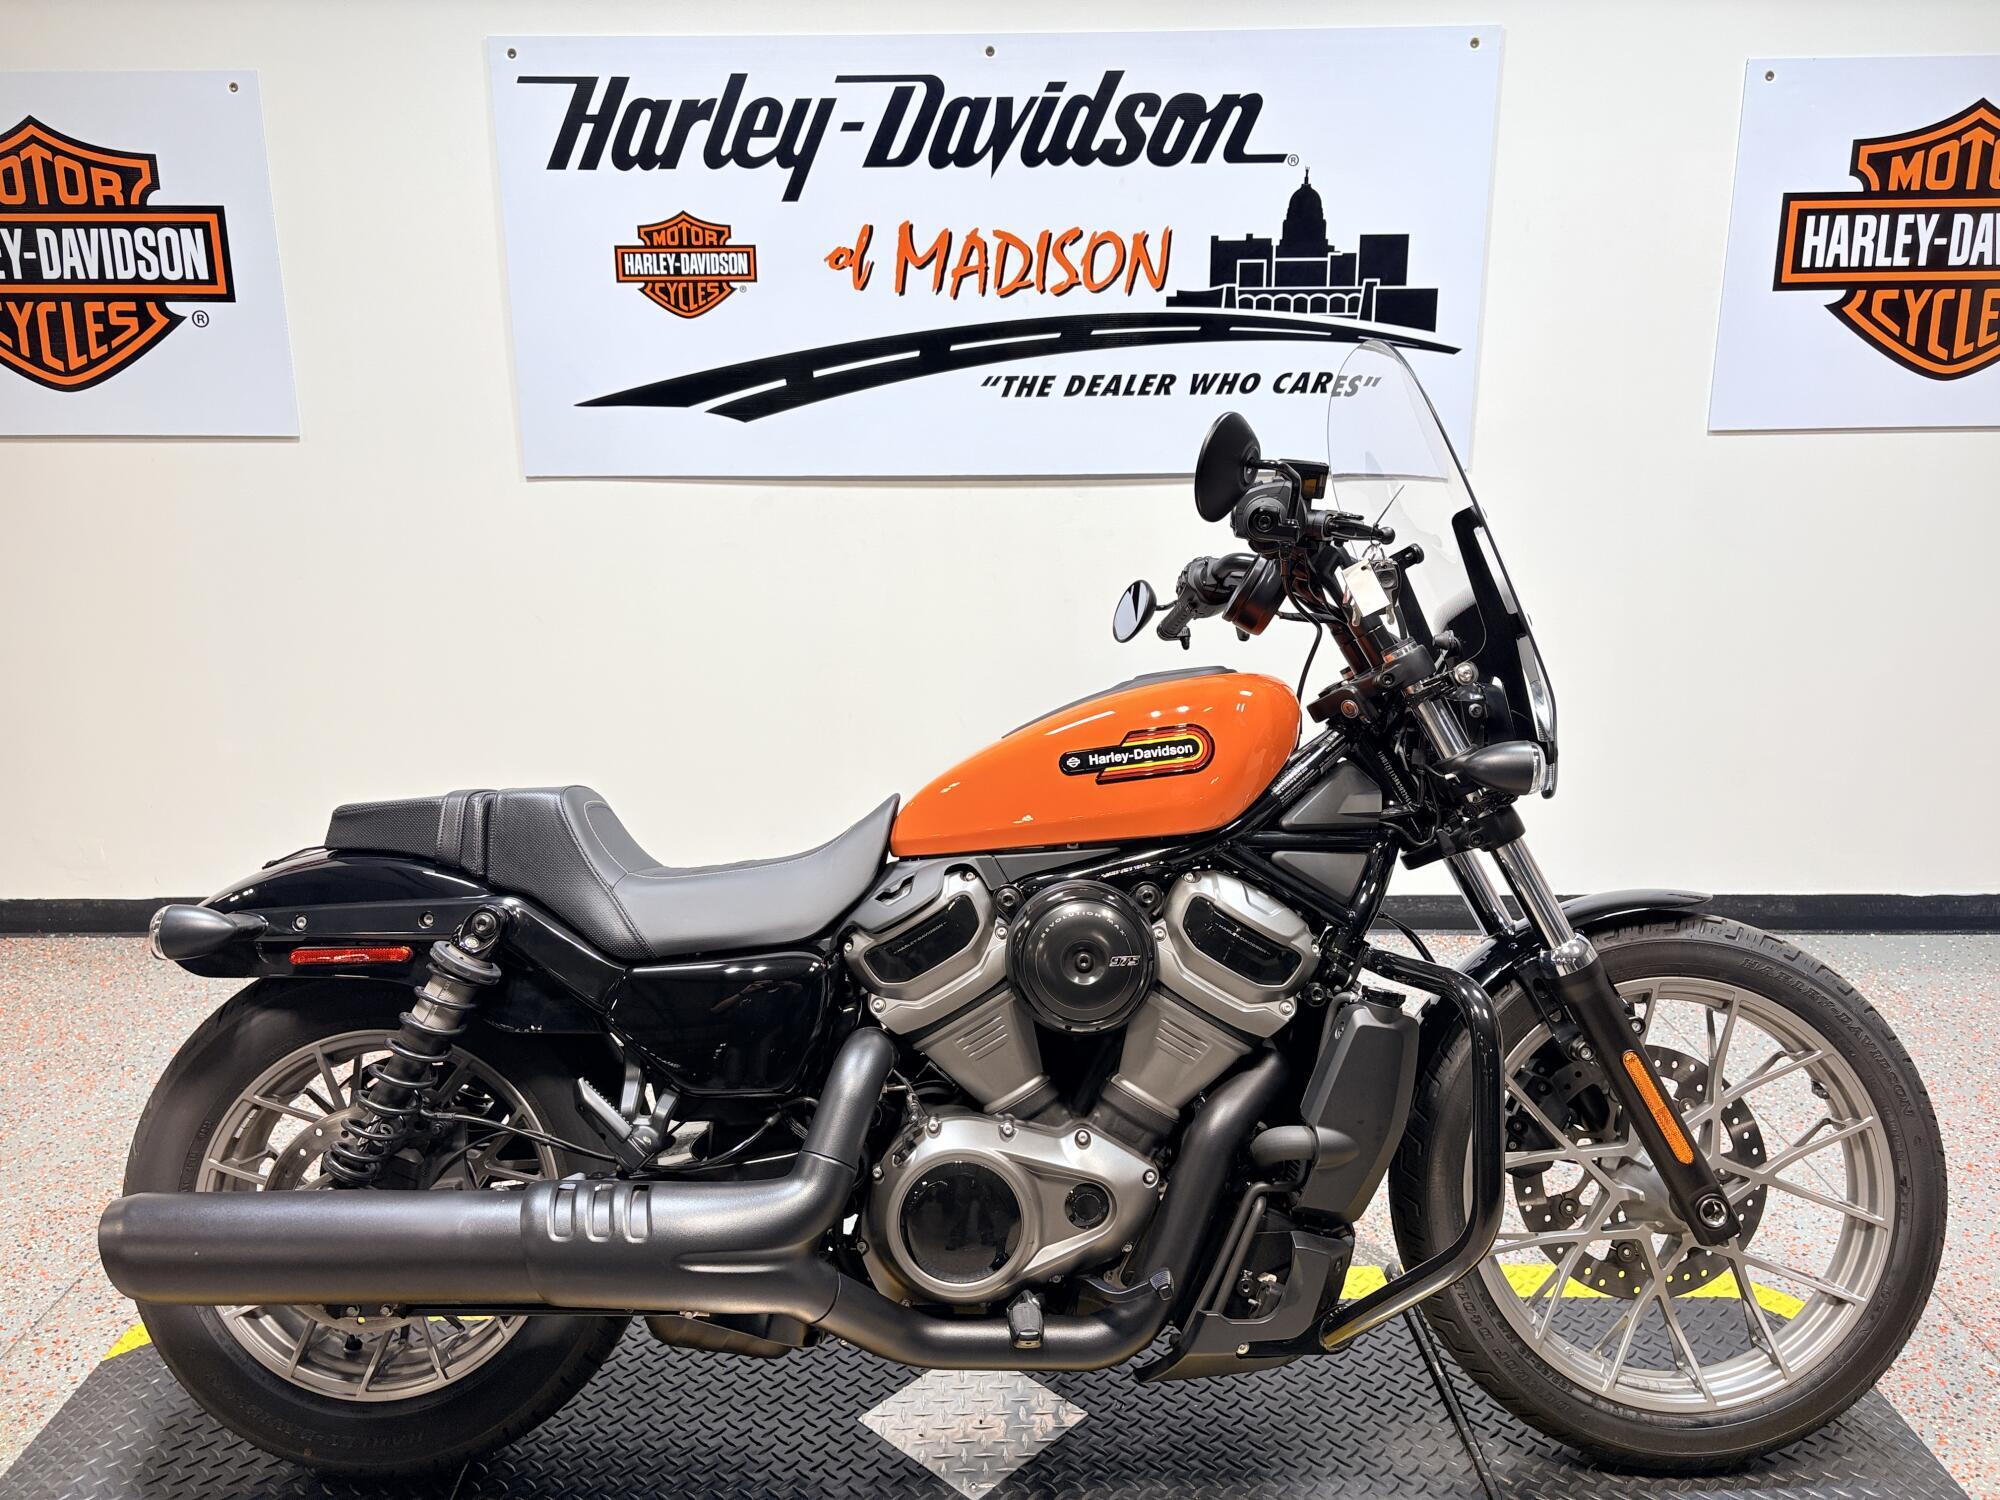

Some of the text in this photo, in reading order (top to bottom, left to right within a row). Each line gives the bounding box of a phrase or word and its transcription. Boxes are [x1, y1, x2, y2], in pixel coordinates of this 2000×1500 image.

[516, 70, 1289, 202] Harley-Davidson
[652, 220, 718, 246] MOTOR
[1801, 213, 2000, 269] HARLEY-DA
[623, 252, 749, 275] HARLEY-DAVIDSON
[824, 219, 1173, 300] of MADISON
[654, 282, 720, 312] CYCLES
[1063, 374, 1177, 398] DEALER
[1188, 372, 1262, 396] WHO
[1088, 743, 1194, 766] Harley-Davidson
[1040, 911, 1102, 939] REVOLUTION
[1109, 955, 1141, 968] 975
[1739, 957, 1914, 1116] HARLEY-DAVIDSON
